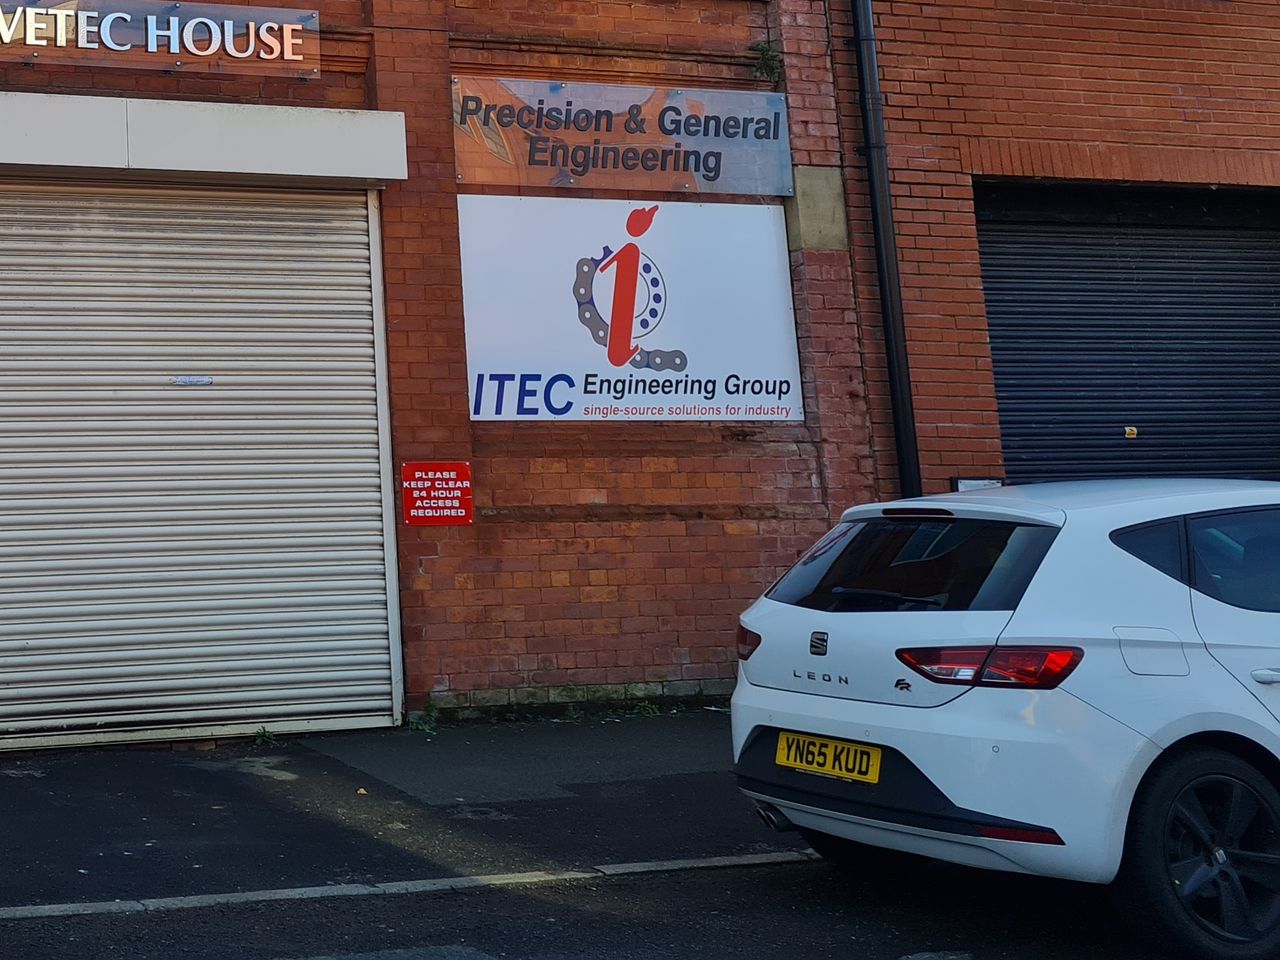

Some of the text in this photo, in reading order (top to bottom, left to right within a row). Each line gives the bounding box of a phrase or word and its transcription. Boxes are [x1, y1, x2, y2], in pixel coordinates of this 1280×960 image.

[147, 14, 304, 62] HOUSE
[459, 95, 780, 140] Precision & General
[528, 136, 722, 182] Engineering
[473, 373, 791, 416] ITEC Engineering Group
[583, 404, 792, 419] single-source solutions for industry
[793, 669, 849, 685] LEON
[894, 678, 912, 692] FR
[785, 736, 829, 768] YN65
[832, 745, 871, 776] KUD
